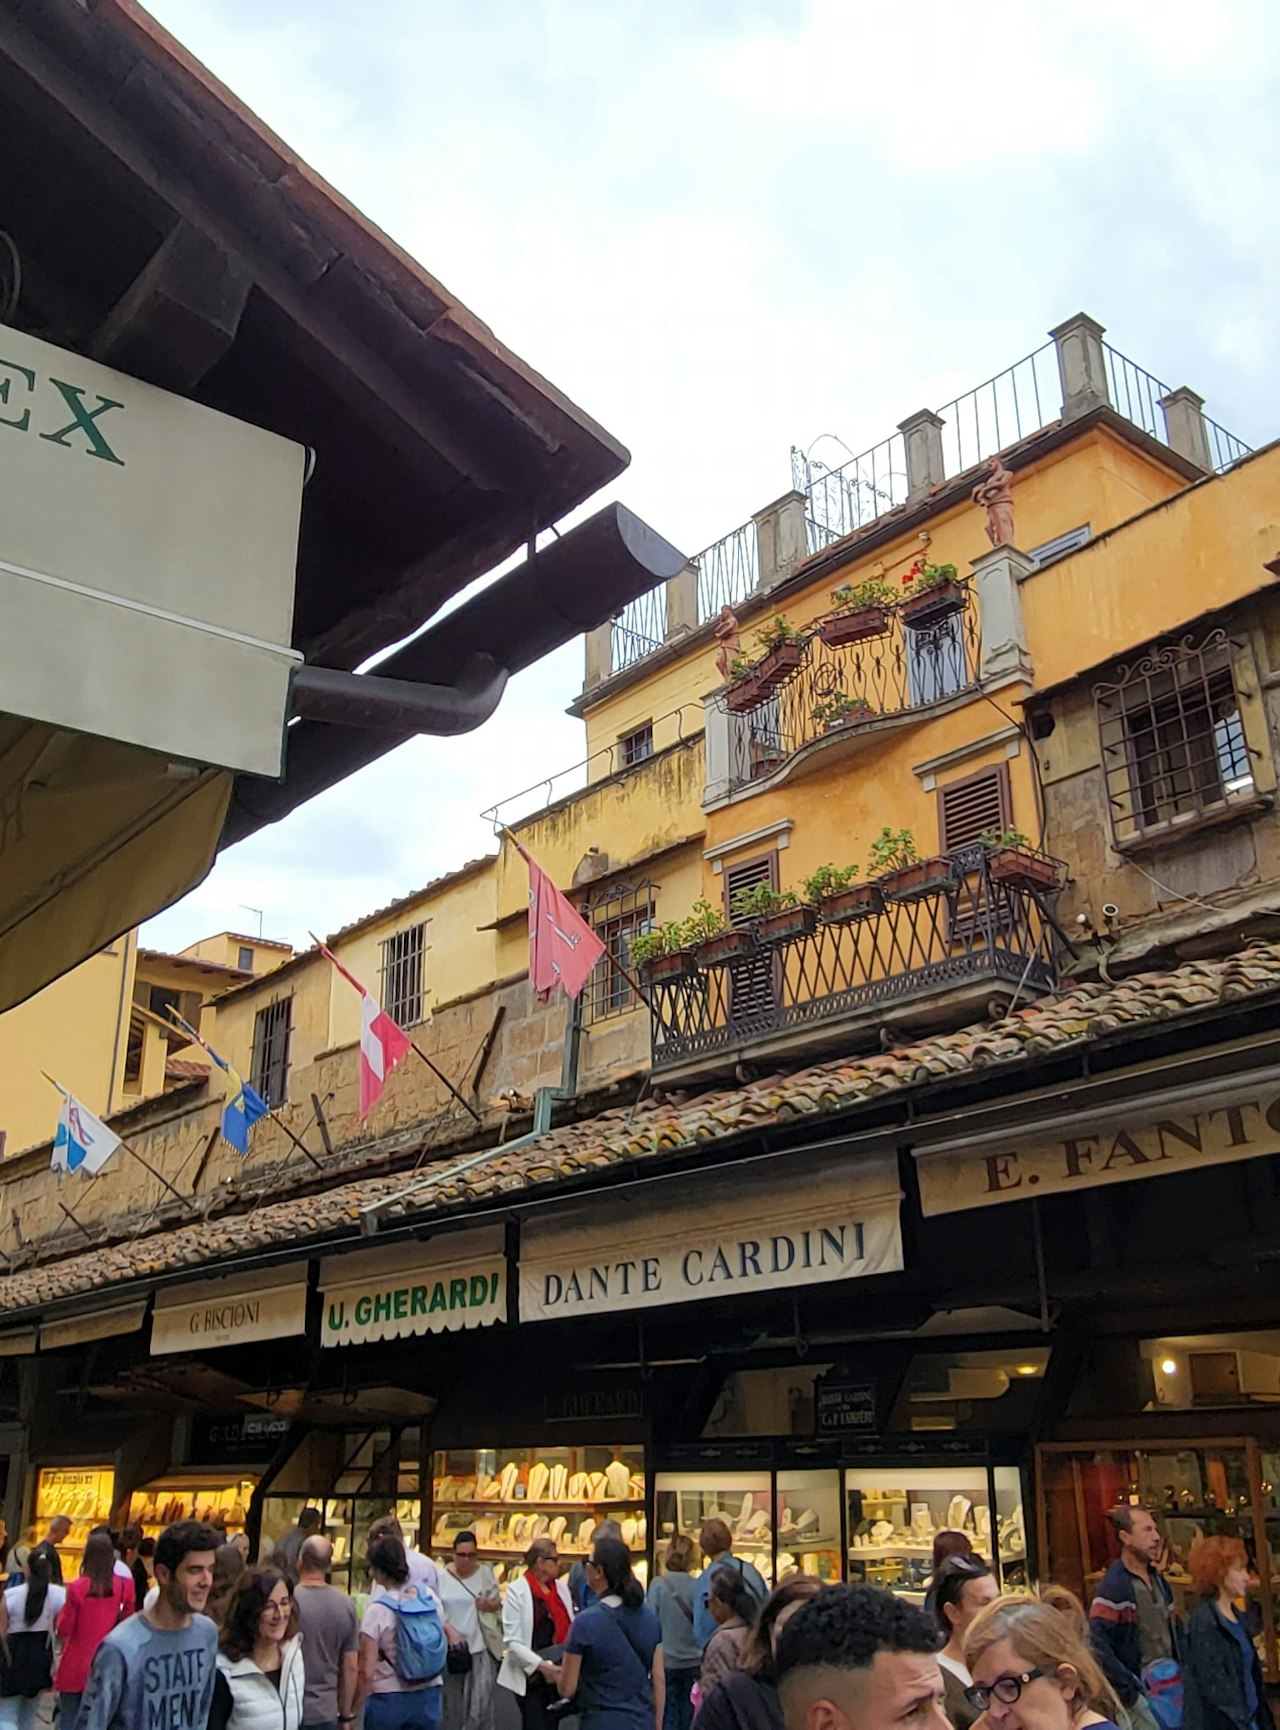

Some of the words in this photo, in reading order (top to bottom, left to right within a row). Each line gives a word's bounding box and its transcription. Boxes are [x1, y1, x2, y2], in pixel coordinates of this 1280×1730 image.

[982, 1151, 1040, 1192] E.
[544, 1257, 662, 1306] DANTE
[682, 1221, 868, 1286] CARDINI
[204, 1301, 261, 1332] BISCIONI
[328, 1302, 349, 1330] U.
[354, 1272, 501, 1325] GHERARDI
[144, 1648, 205, 1694] STATE
